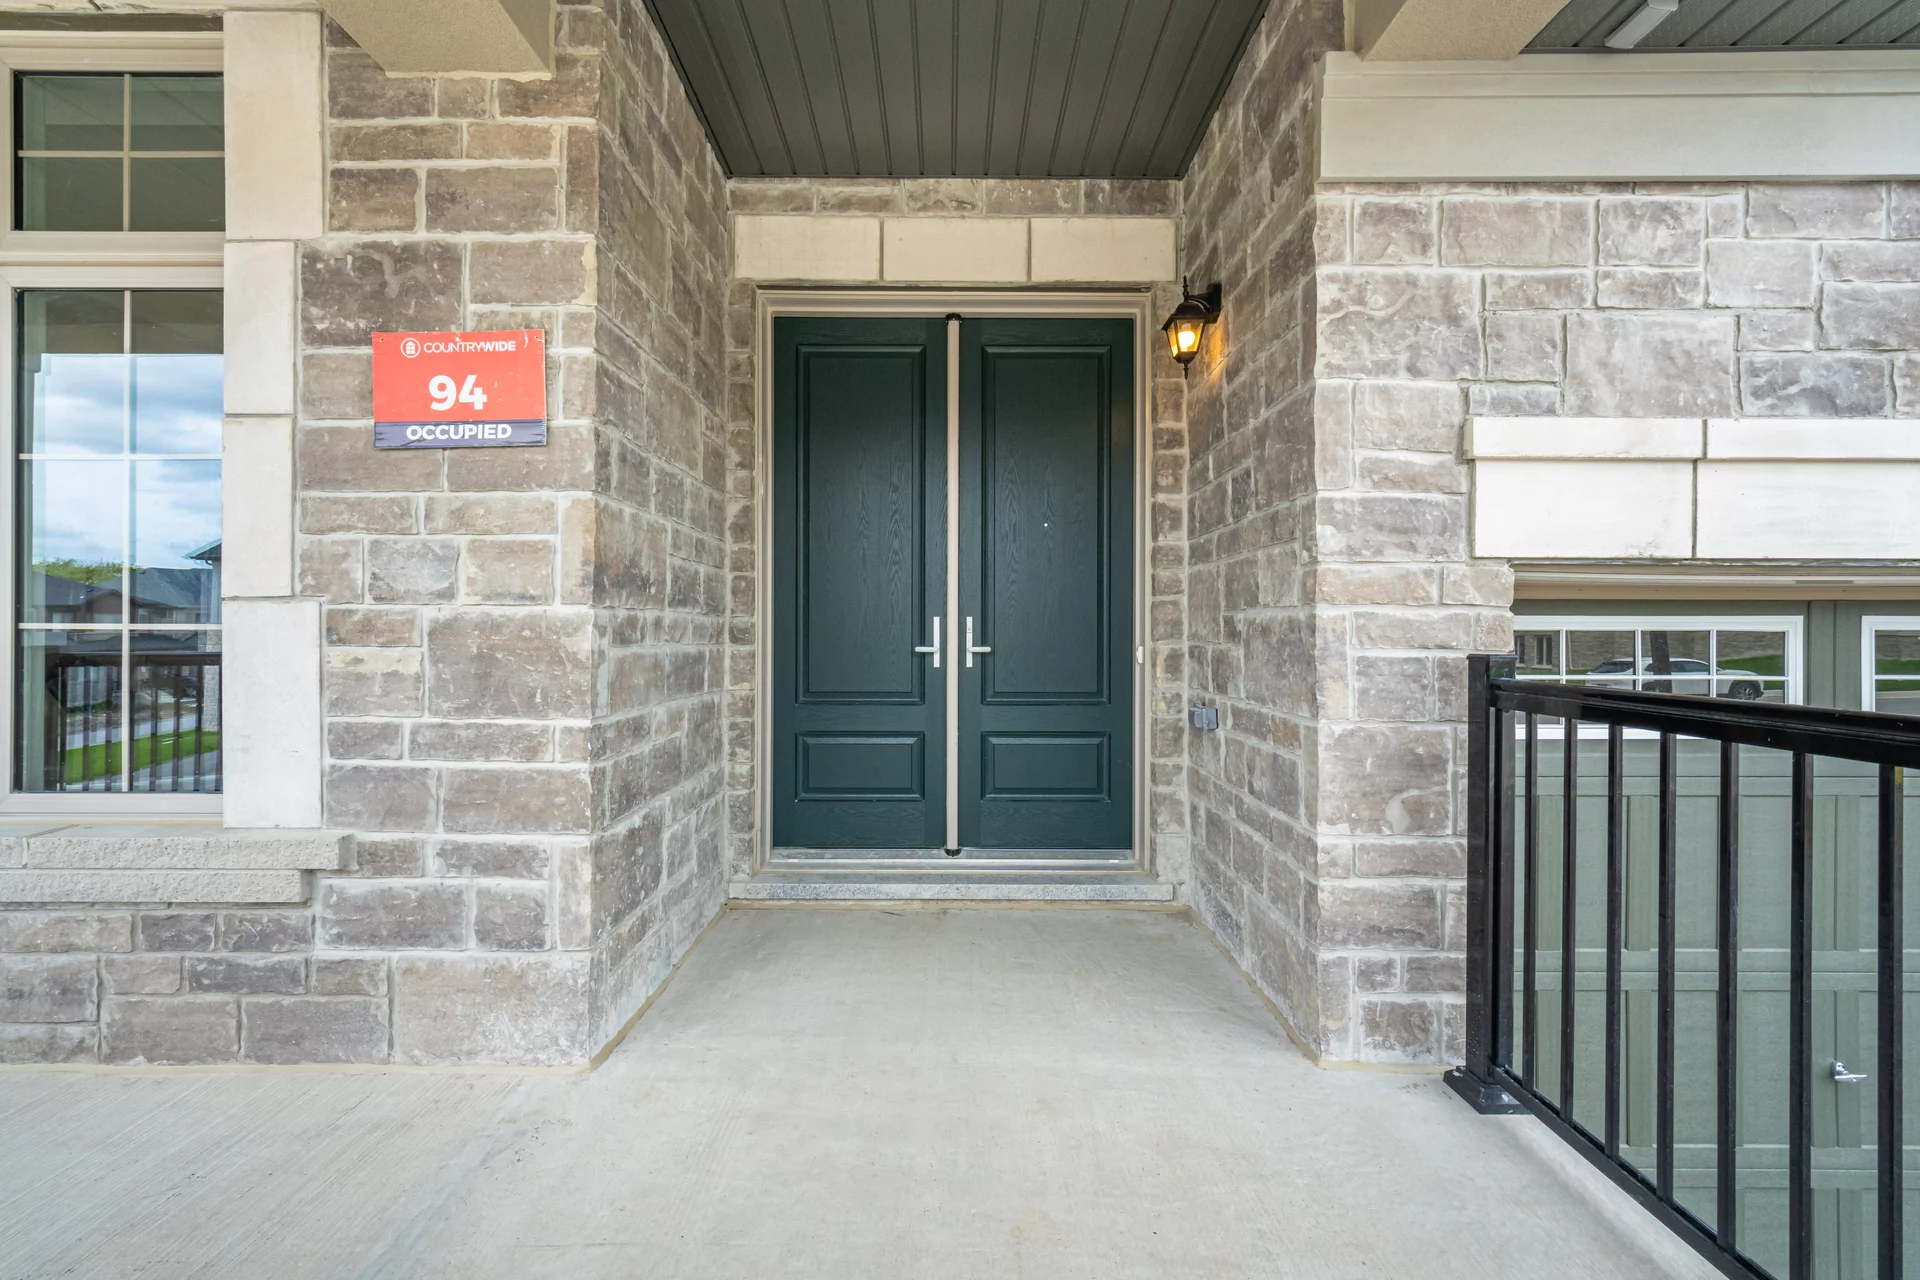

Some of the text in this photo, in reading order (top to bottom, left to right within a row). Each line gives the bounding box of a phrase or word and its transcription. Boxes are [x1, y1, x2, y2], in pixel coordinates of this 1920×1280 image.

[423, 340, 516, 353] COUNTRYWIDE
[428, 374, 487, 411] 94
[406, 424, 512, 440] OCCUPIED
